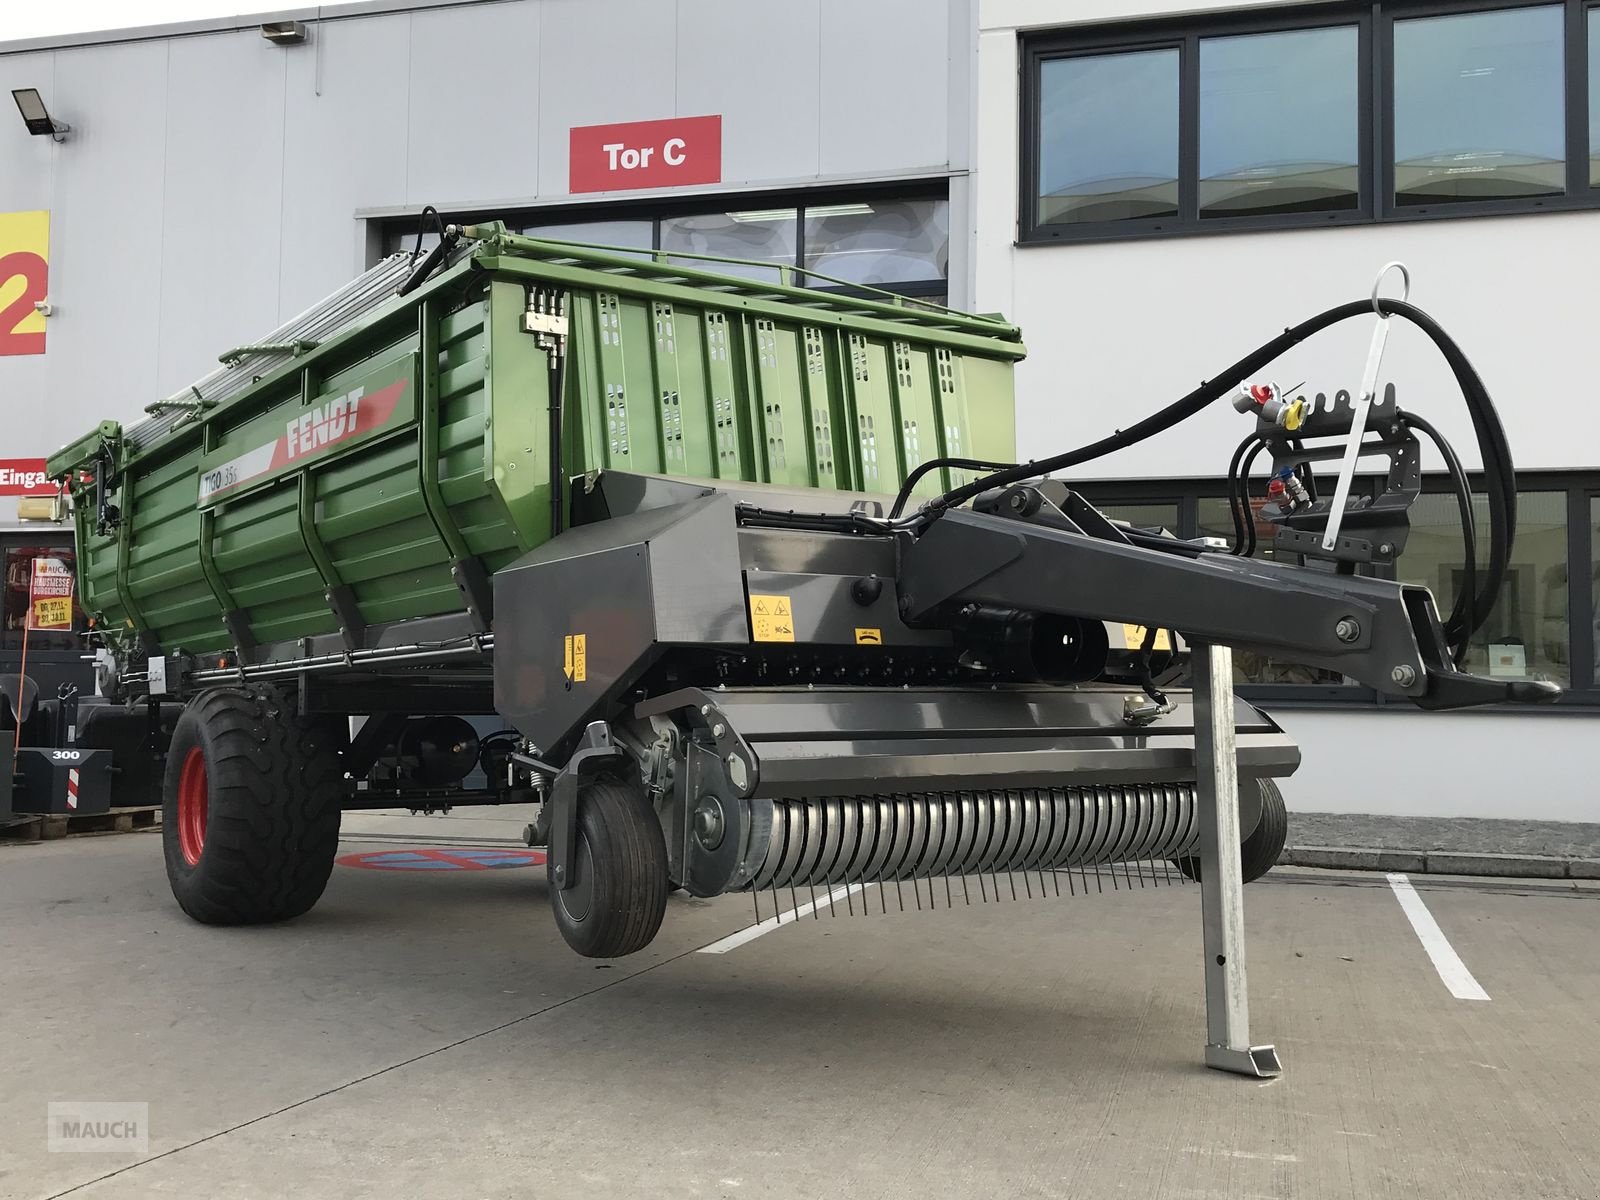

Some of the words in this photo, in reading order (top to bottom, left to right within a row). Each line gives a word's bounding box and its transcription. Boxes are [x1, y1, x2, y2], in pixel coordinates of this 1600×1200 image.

[603, 143, 654, 170] Tor
[663, 138, 686, 165] C
[0, 251, 48, 356] 2
[287, 386, 365, 459] FENDT
[0, 468, 66, 489] Einga
[204, 471, 222, 493] TIGO
[52, 751, 80, 760] 300
